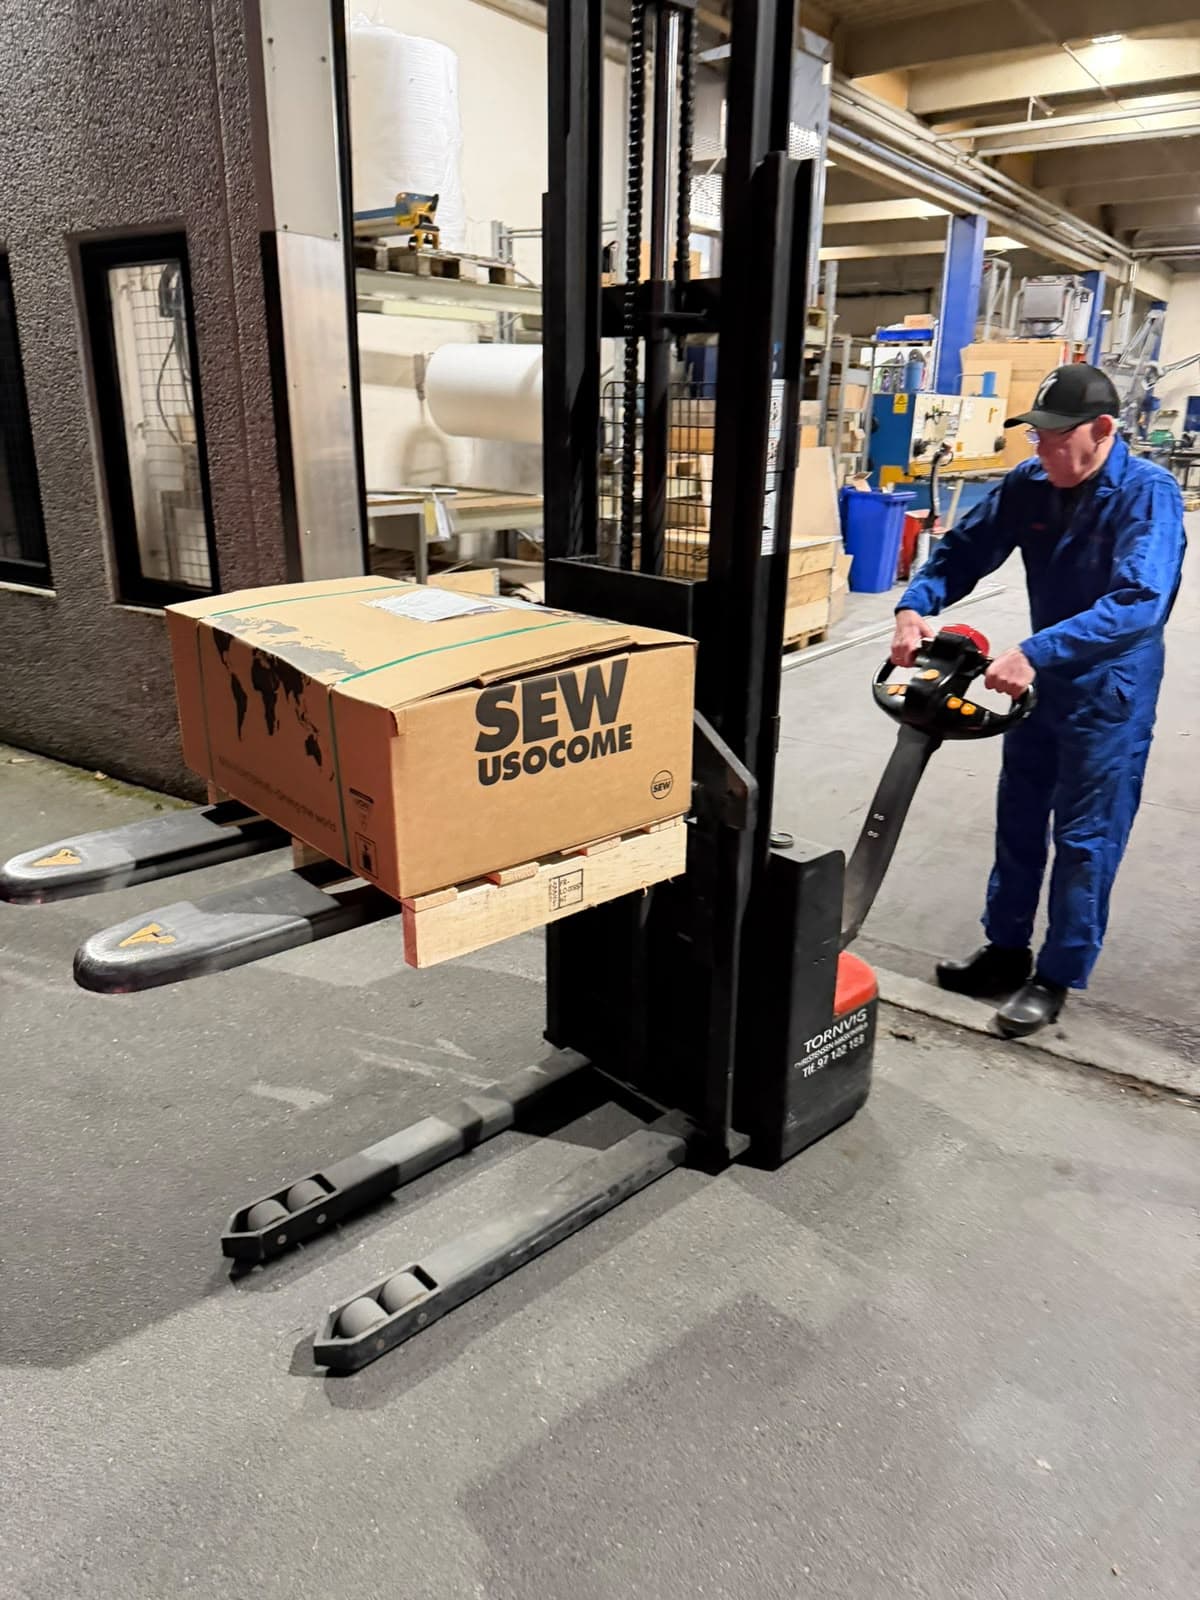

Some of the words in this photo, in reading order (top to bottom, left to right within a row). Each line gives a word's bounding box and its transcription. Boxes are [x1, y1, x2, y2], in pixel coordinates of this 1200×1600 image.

[475, 658, 629, 753] SEW
[478, 724, 633, 787] USOCOME
[652, 780, 671, 793] SEW
